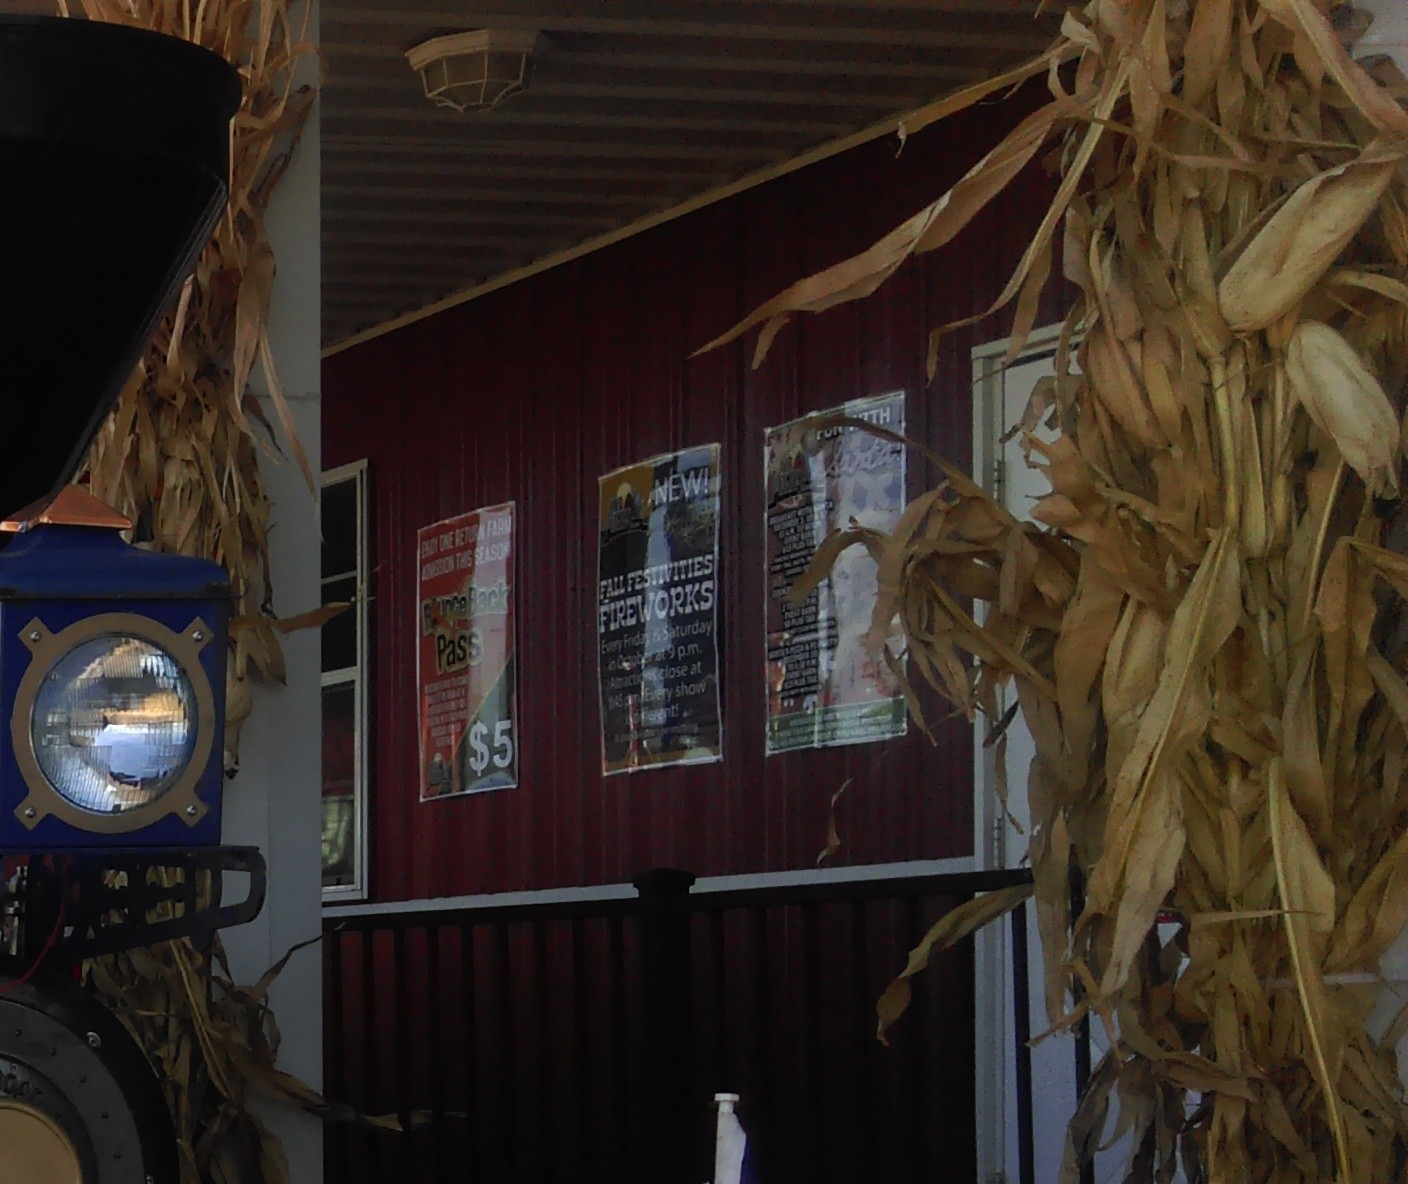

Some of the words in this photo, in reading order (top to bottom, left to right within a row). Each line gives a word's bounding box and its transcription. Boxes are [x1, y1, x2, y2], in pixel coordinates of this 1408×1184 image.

[655, 467, 709, 506] NEW!
[439, 531, 454, 552] ONE
[455, 521, 485, 548] RETURN
[487, 515, 512, 539] FARM
[421, 555, 455, 581] ADMISSION
[456, 549, 473, 571] THIS
[475, 540, 510, 566] SEASON
[599, 575, 626, 600] FALL
[627, 554, 713, 592] FESTIVITIES
[599, 579, 715, 633] FIREWORKS
[436, 632, 480, 669] Pass
[601, 638, 624, 656] Every
[663, 619, 713, 641] Saturday
[655, 648, 667, 662] at
[668, 644, 675, 660] 9
[678, 642, 703, 661] p.m.
[661, 664, 688, 680] close
[690, 661, 702, 676] at
[675, 679, 707, 698] show
[468, 720, 514, 777] $5
